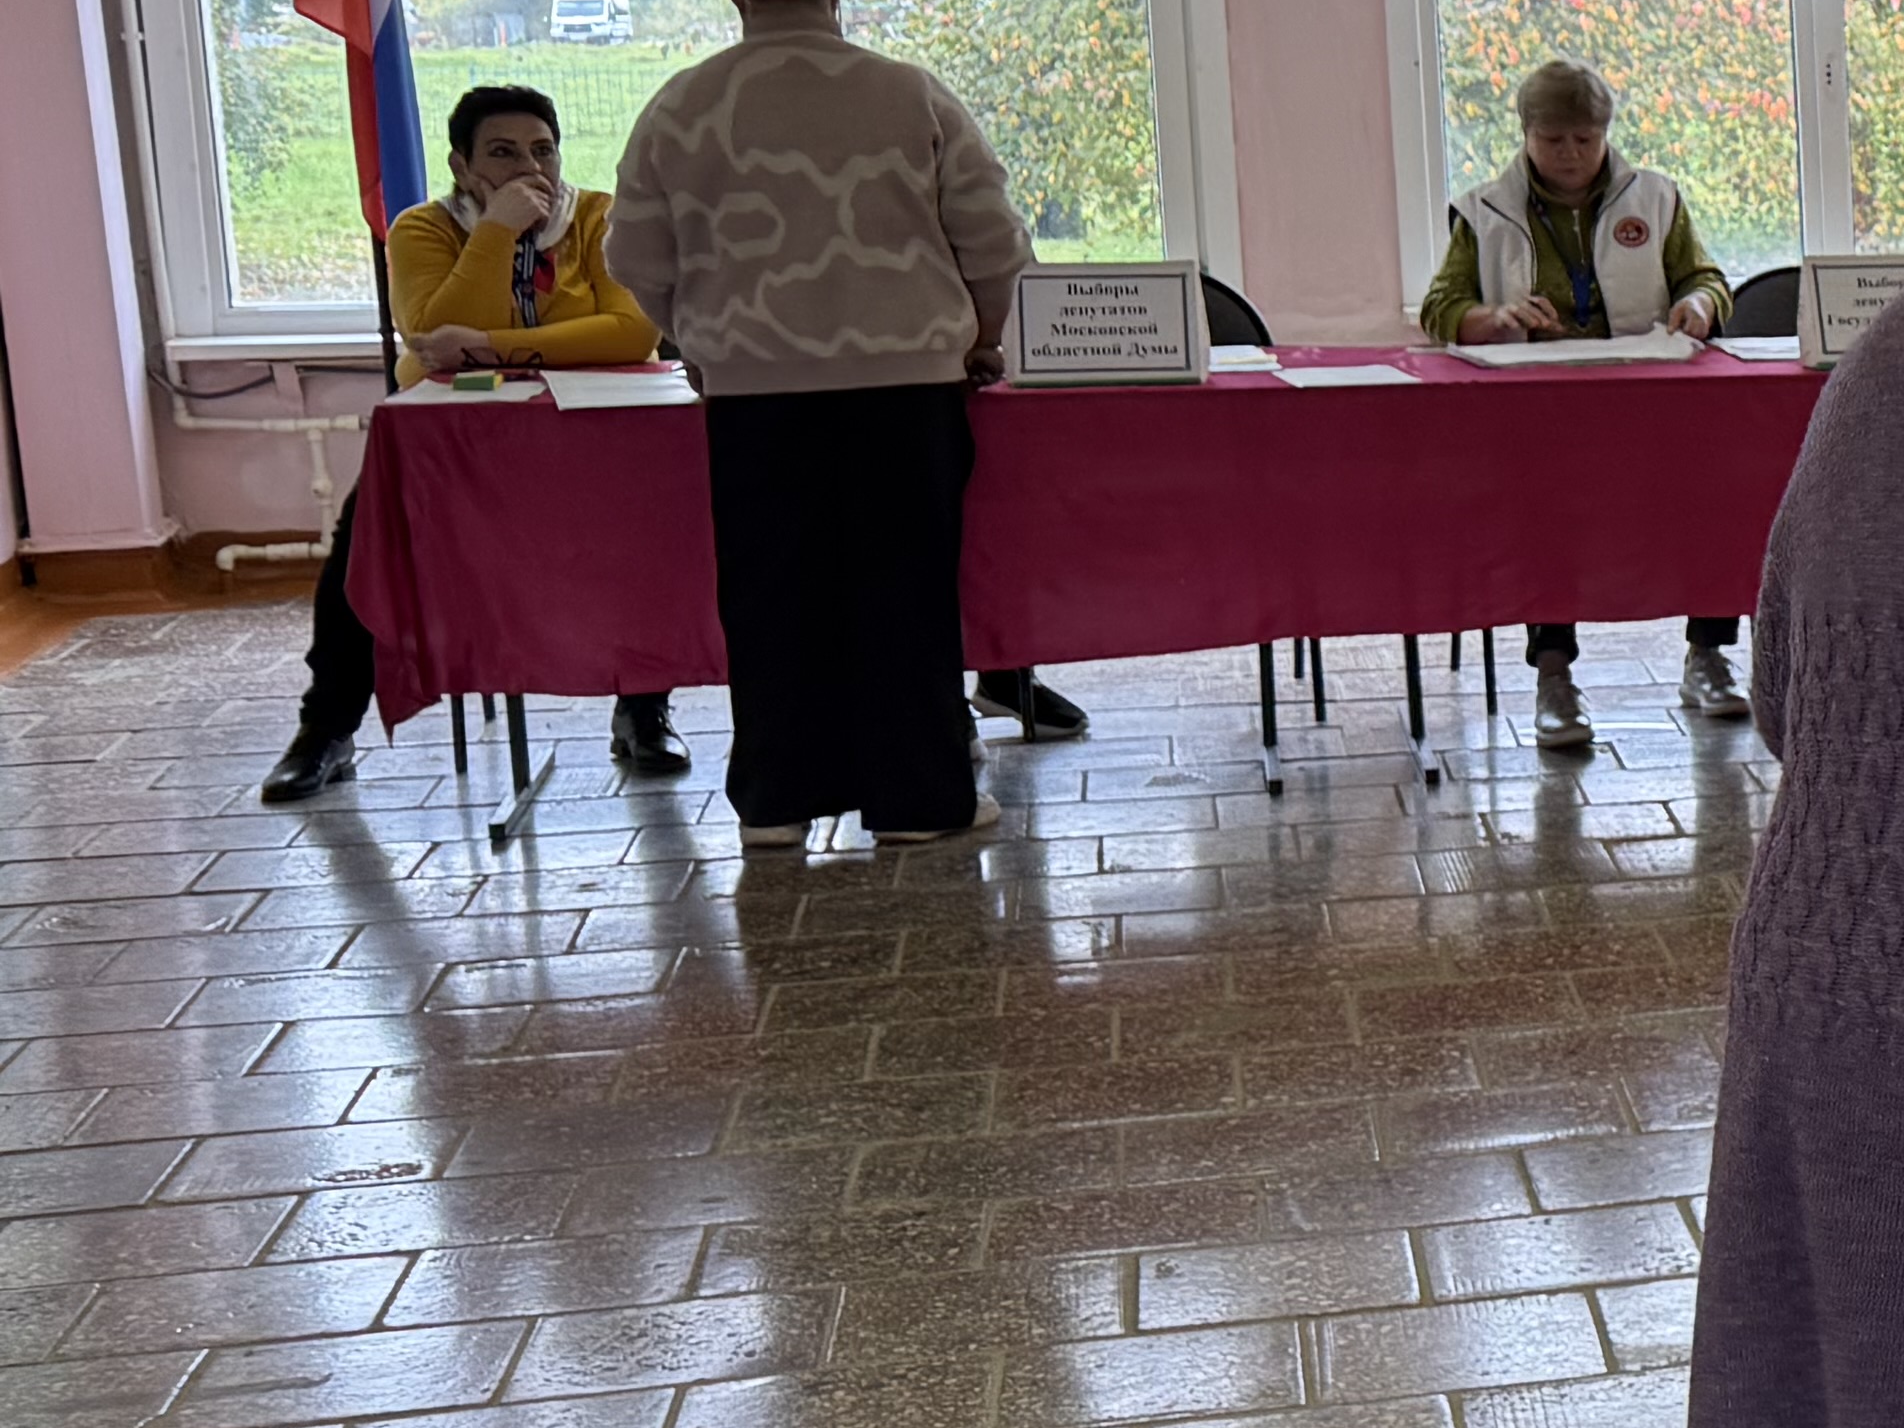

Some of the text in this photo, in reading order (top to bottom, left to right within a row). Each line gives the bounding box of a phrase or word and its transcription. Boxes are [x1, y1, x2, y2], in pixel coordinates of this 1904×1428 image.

[1067, 282, 1139, 300] Выборы
[1853, 298, 1893, 308] депу
[1059, 304, 1148, 320] депутатов
[1050, 321, 1158, 337] Московской
[1031, 341, 1179, 359] областной Думы
